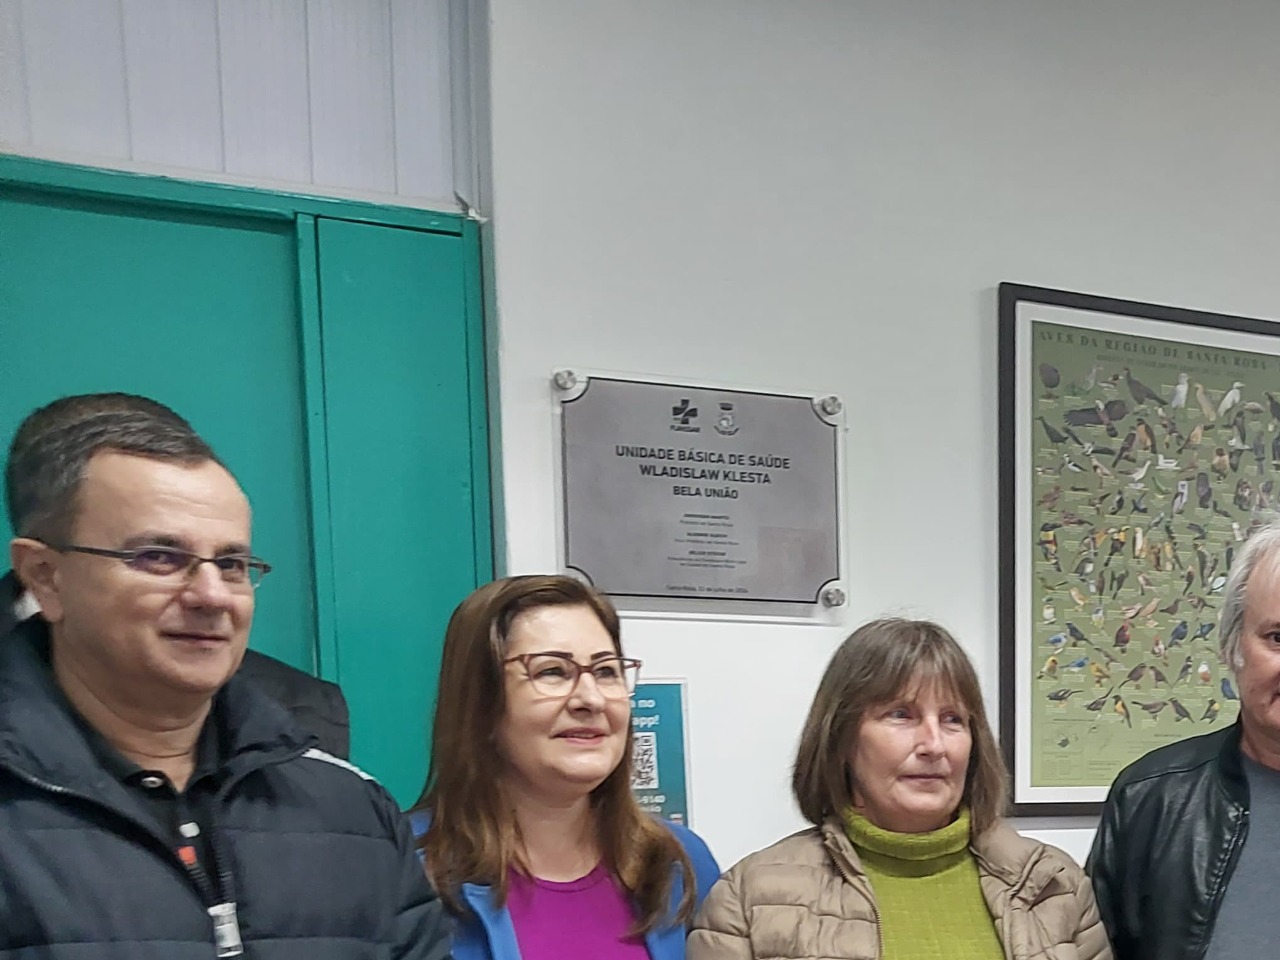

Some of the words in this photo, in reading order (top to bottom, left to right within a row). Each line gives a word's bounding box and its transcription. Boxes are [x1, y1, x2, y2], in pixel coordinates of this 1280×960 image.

[1081, 335, 1098, 348] DA
[615, 445, 675, 460] UNIDADE
[678, 448, 725, 464] BÁSICA
[728, 454, 746, 466] DE
[748, 454, 791, 469] SAÚDE
[639, 464, 720, 480] WLADISLAW
[723, 470, 772, 484] KLESTA
[673, 486, 702, 497] BELA
[704, 486, 739, 499] UNIÃO
